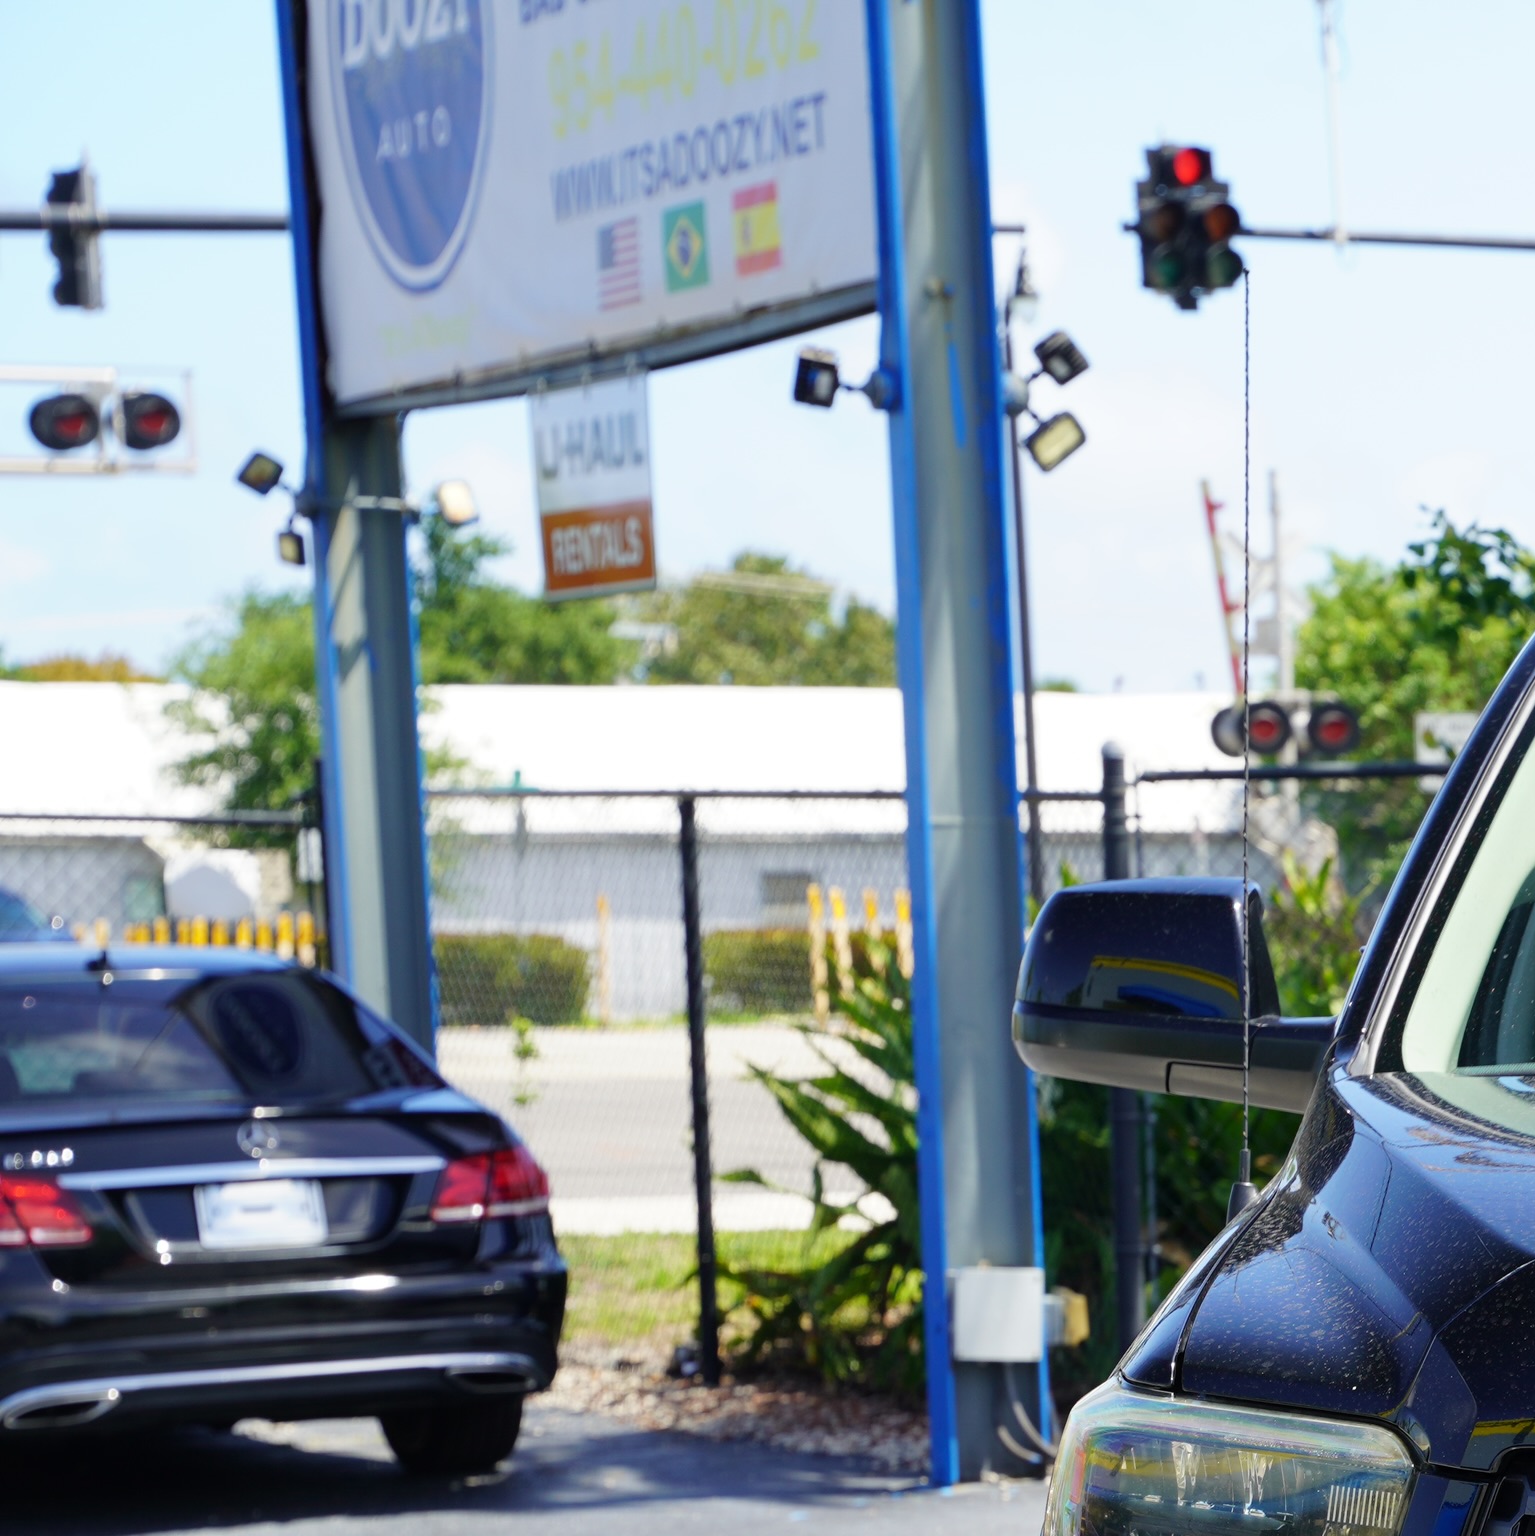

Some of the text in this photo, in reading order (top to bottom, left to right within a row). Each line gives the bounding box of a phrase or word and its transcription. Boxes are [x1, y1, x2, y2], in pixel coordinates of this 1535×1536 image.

[375, 103, 451, 164] AUTO
[550, 89, 828, 224] WWW.ITSADOOZY.NET
[550, 514, 646, 576] RENTALS
